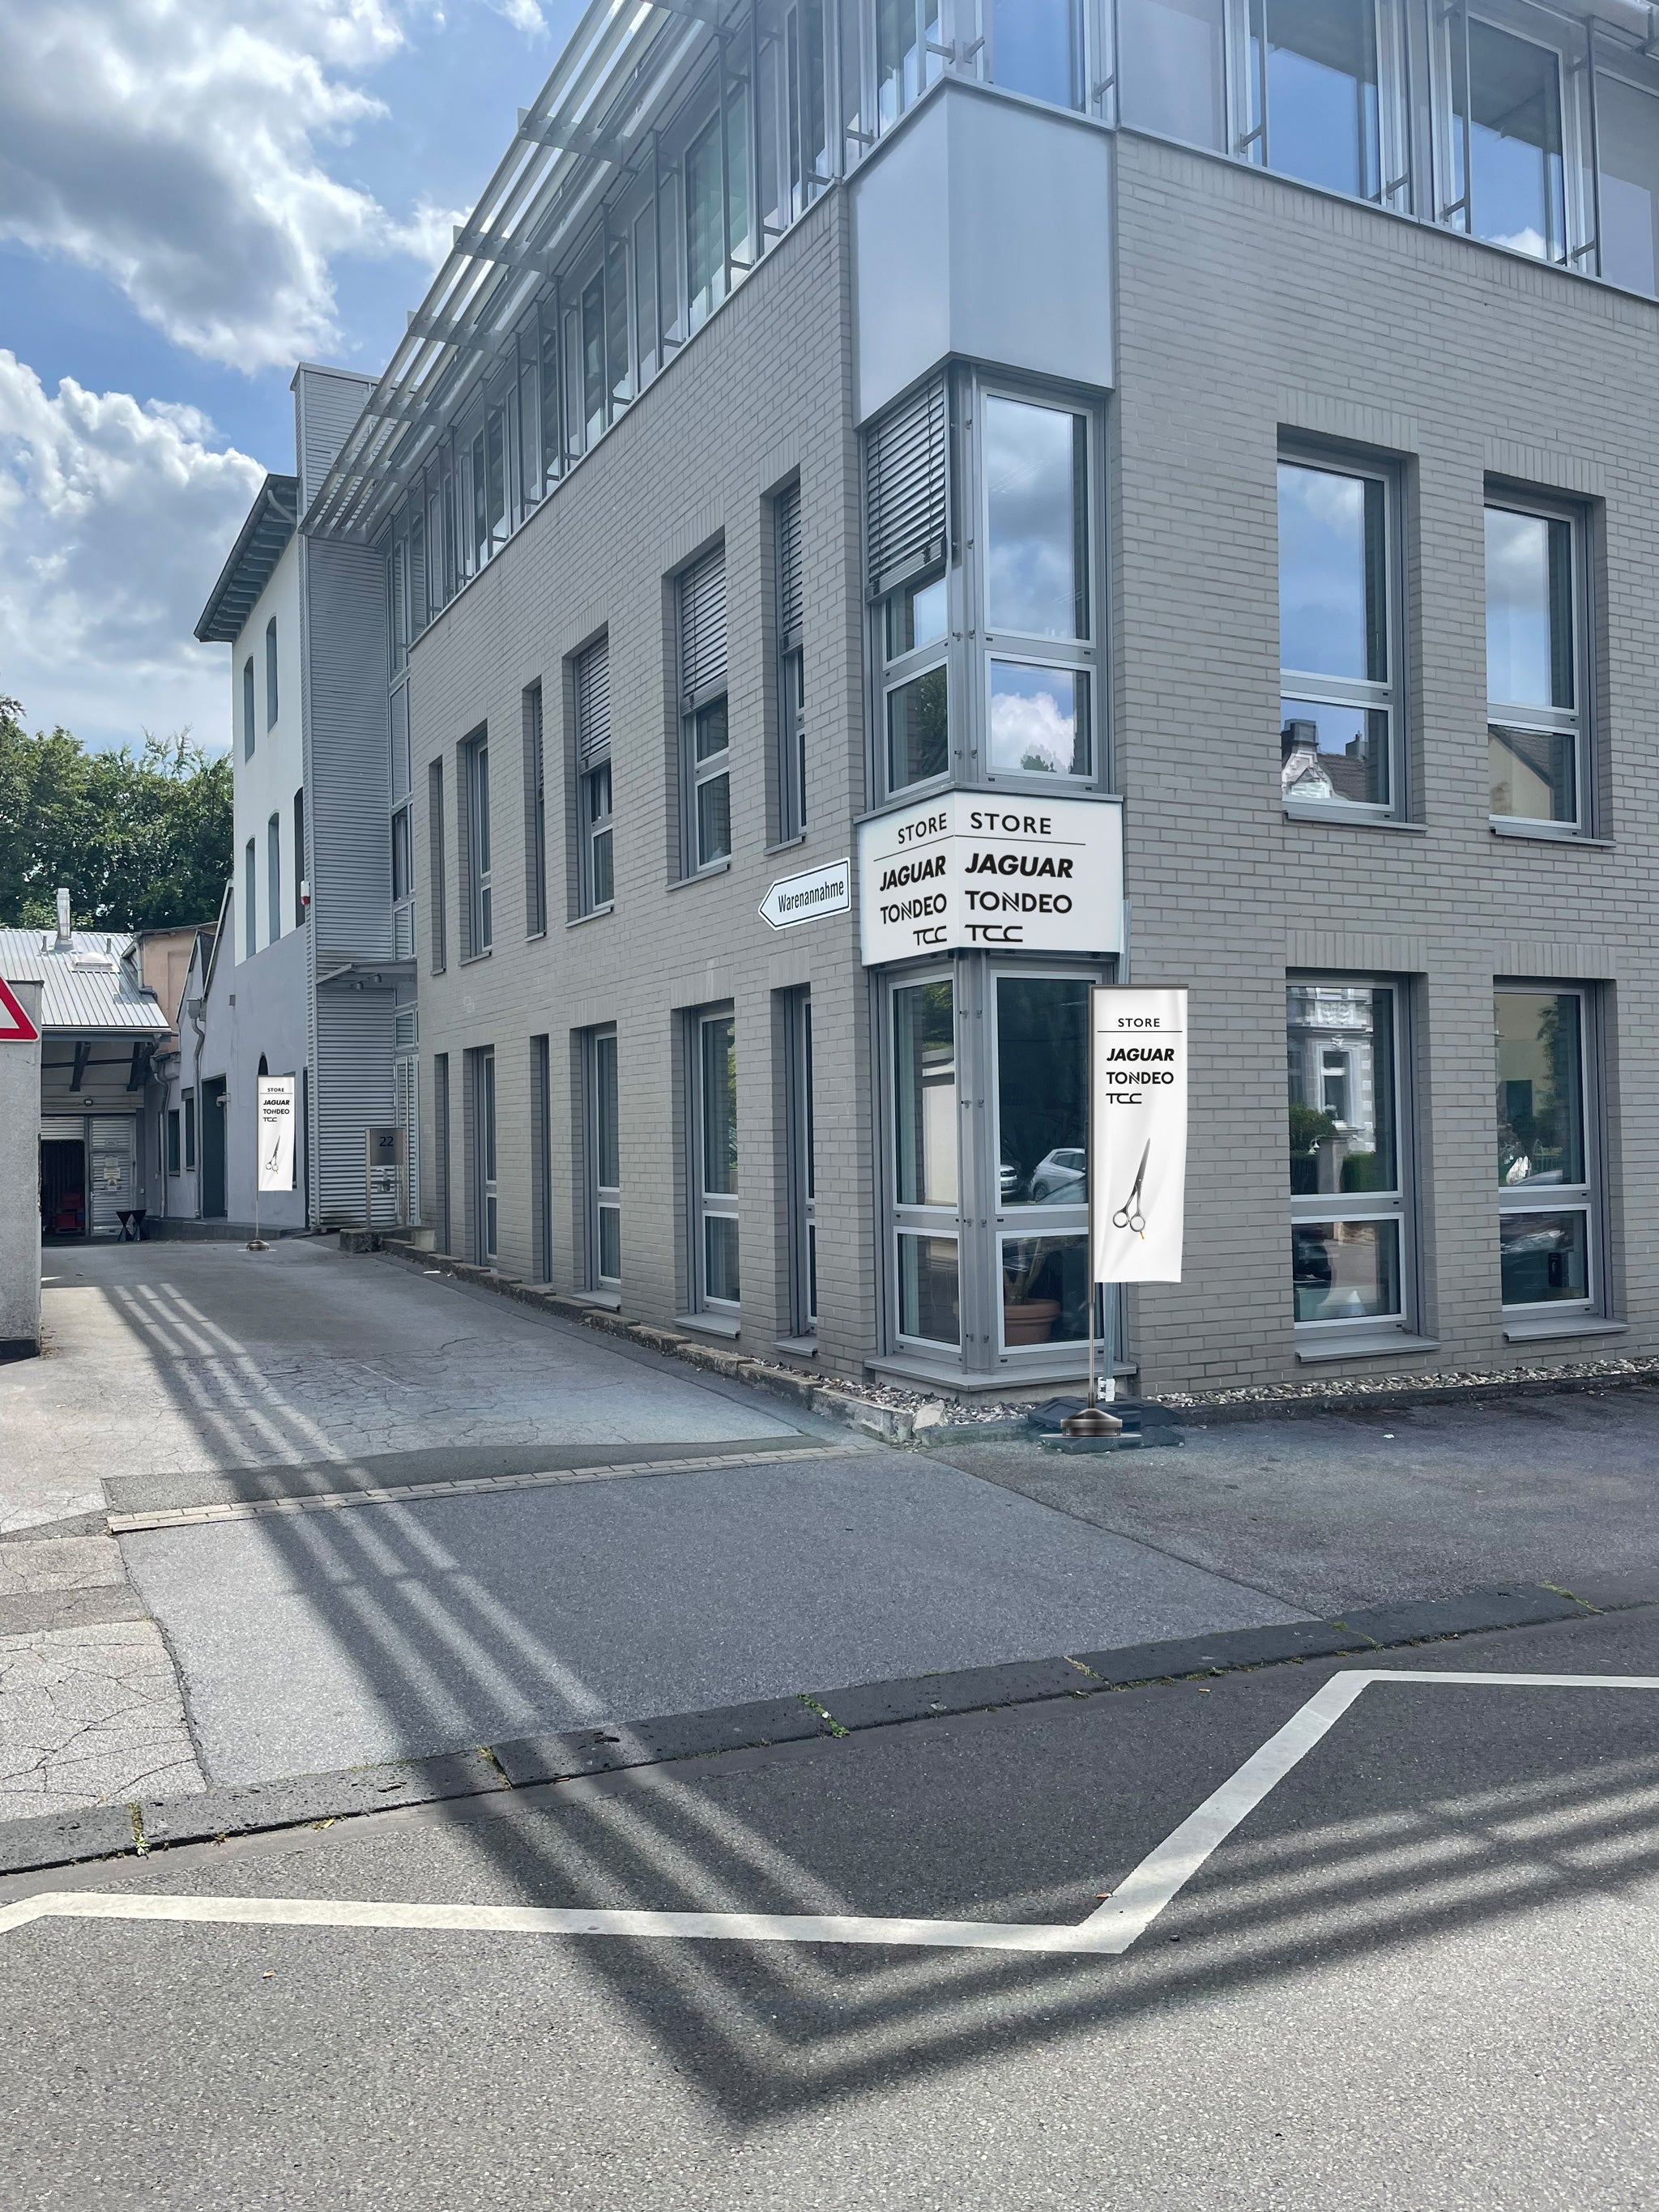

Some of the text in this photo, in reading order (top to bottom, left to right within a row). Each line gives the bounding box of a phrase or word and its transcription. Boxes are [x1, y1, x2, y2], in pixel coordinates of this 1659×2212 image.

[898, 812, 948, 845] STORE
[970, 812, 1051, 835] STORE
[879, 855, 947, 892] JAGUAR
[965, 853, 1073, 879] JAGUAR
[778, 880, 844, 913] Warenannahme
[965, 890, 1073, 914] TONDEO
[880, 893, 947, 925] TONDEO
[913, 925, 947, 946] TCC
[964, 924, 1023, 943] TCC
[1118, 1017, 1160, 1028] STORE
[1106, 1047, 1175, 1062] JAGUAR
[1106, 1071, 1175, 1085] TONDEO
[1105, 1093, 1142, 1105] TCC
[379, 1136, 394, 1147] 22
